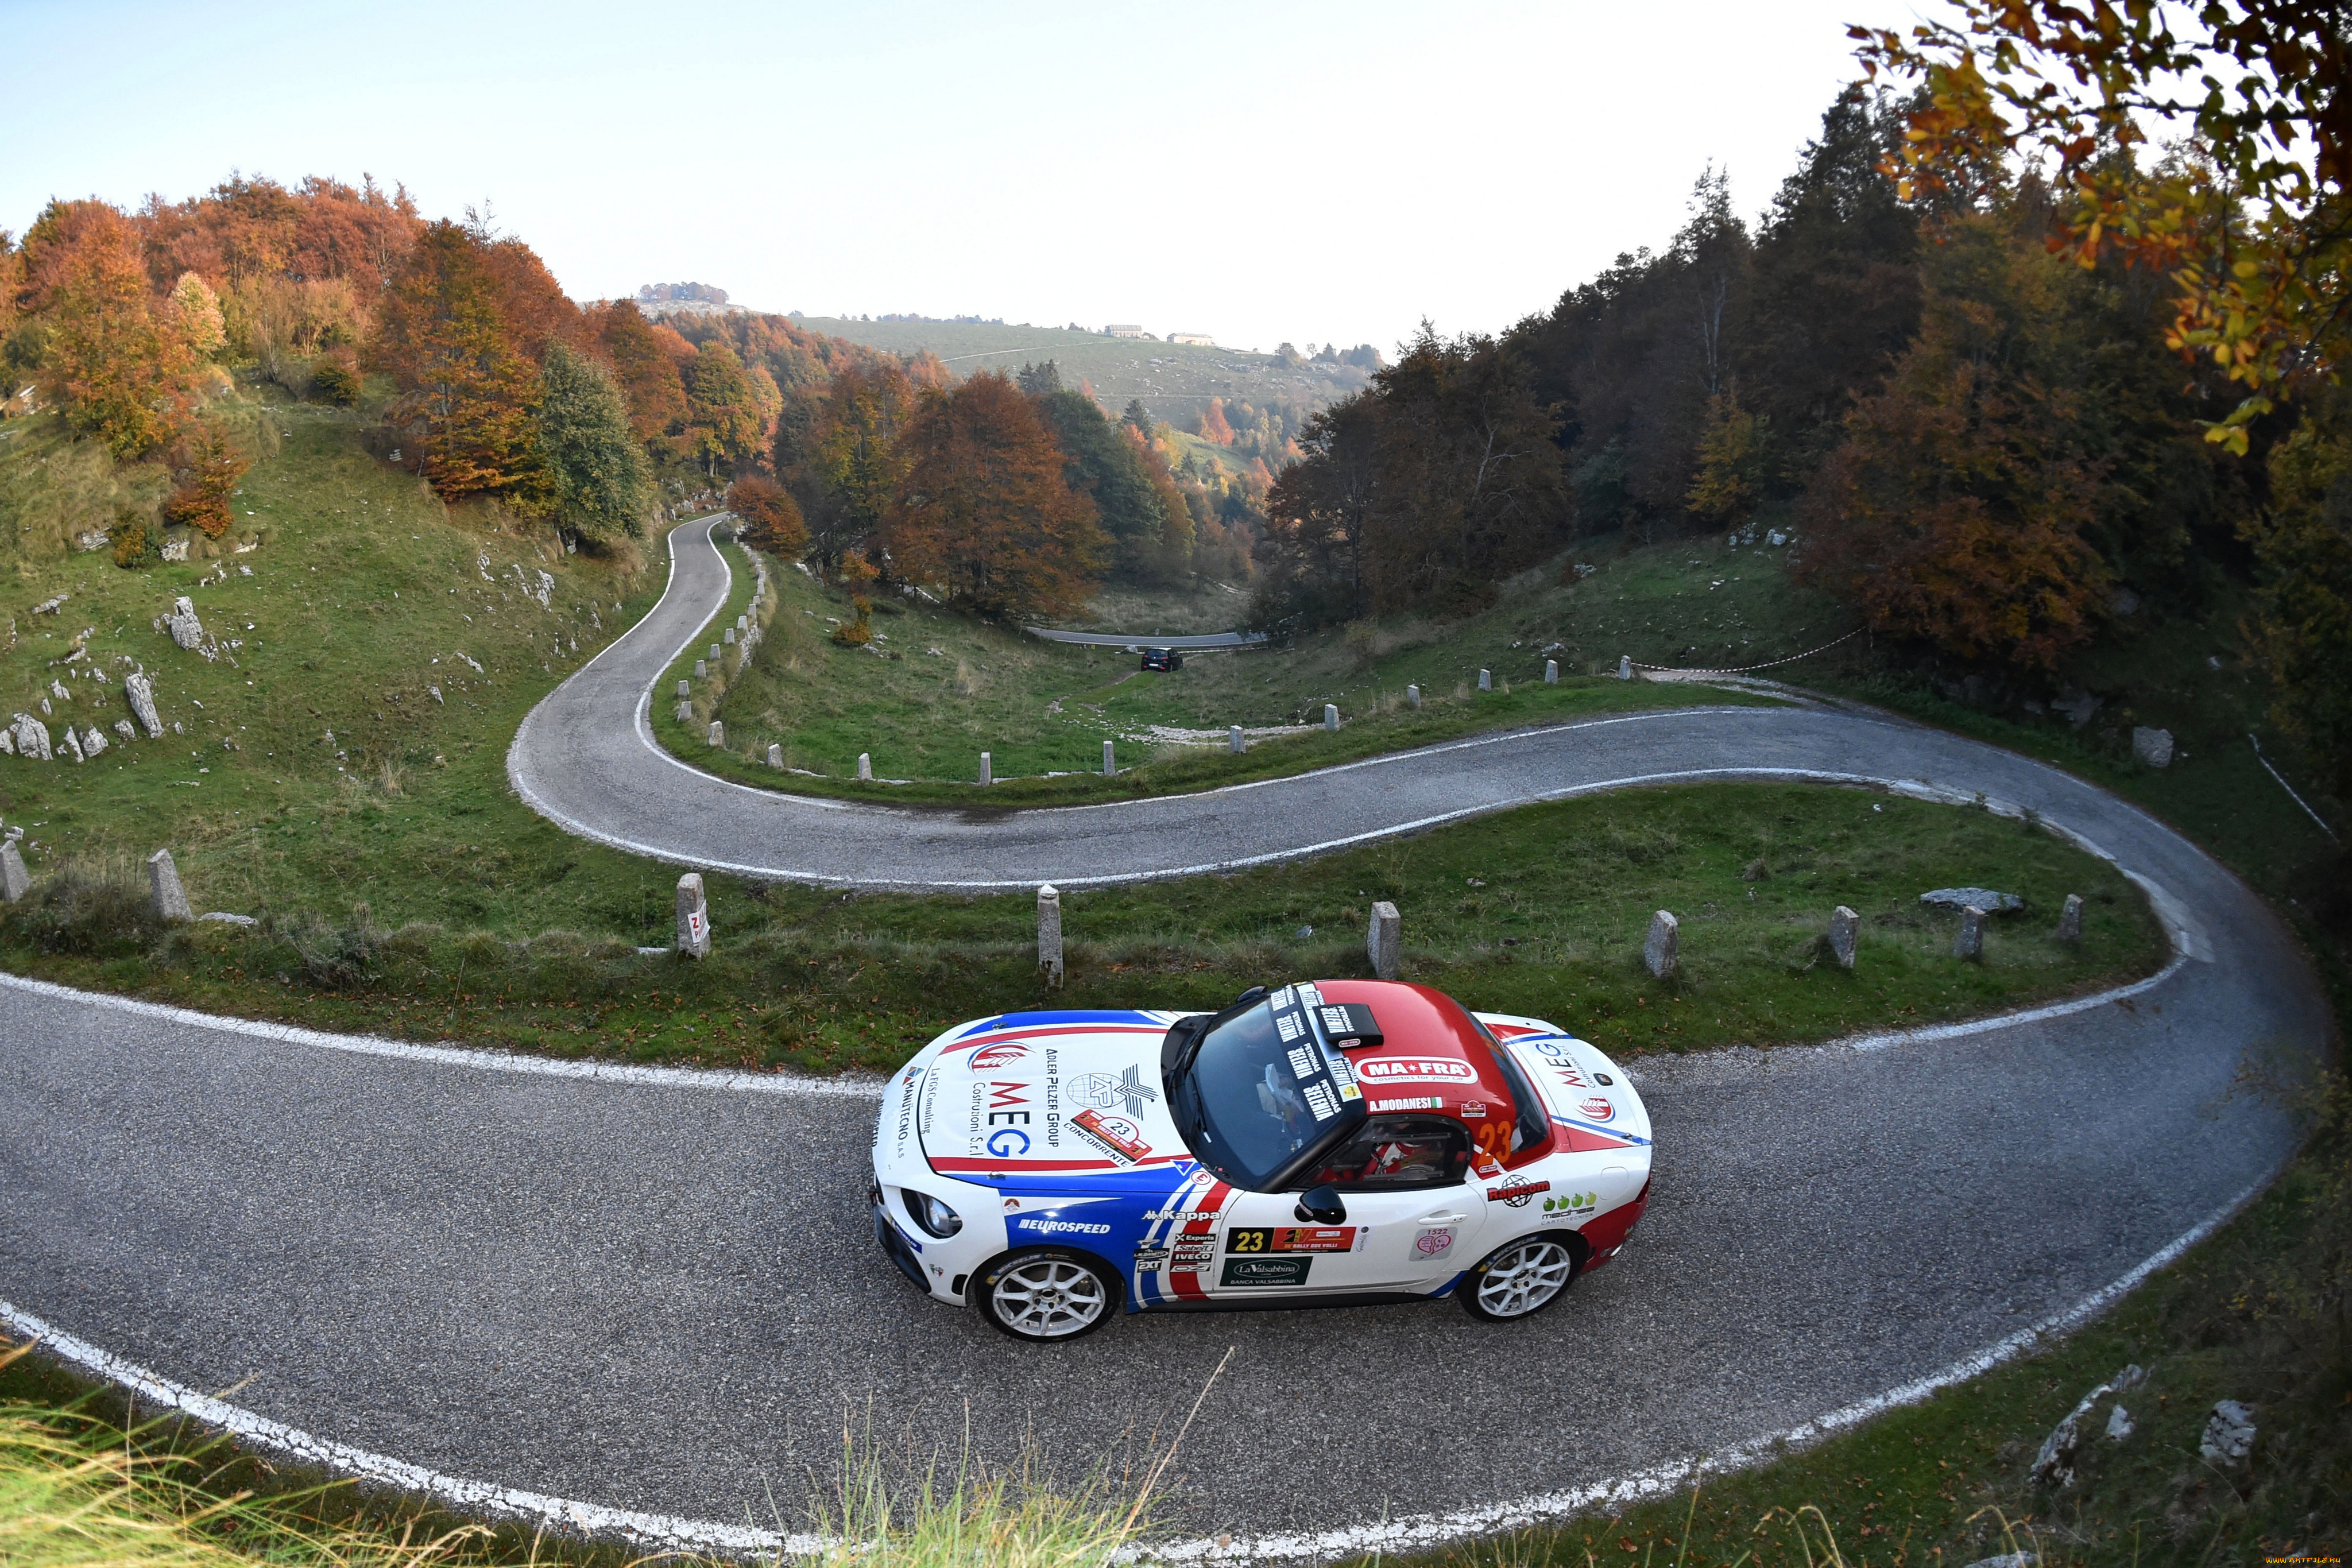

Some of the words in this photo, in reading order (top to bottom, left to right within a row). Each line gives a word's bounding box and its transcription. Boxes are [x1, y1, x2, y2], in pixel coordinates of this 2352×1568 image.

[1276, 1016, 1298, 1042] SELENIA
[1291, 1011, 1306, 1036] PETRONAS
[1320, 1008, 1347, 1033] SELENIA
[1337, 1006, 1355, 1032] PETRONAS
[1046, 1049, 1058, 1074] ADLER
[1287, 1047, 1314, 1079] SELENIA
[1304, 1043, 1321, 1072] PETRONAS
[1343, 1057, 1359, 1082] PETRONAS
[1535, 1044, 1587, 1087] MEG
[1328, 1059, 1352, 1086] SELENIA
[1046, 1077, 1058, 1110] PELZER
[1303, 1083, 1334, 1121] SELENIA
[1320, 1079, 1341, 1113] PETRONAS
[1370, 1097, 1432, 1112] A.MODANESI
[898, 1081, 915, 1140] MANUTECNO
[920, 1092, 937, 1135] Consulting
[970, 1082, 986, 1132] Costruzioni
[987, 1082, 1032, 1157] MEG
[1047, 1113, 1059, 1147] GROUP
[1110, 1122, 1130, 1135] 23
[1063, 1122, 1130, 1167] CONCORRENTE
[1477, 1121, 1511, 1166] 23
[1488, 1181, 1549, 1201] Rapicom
[1163, 1210, 1220, 1221] Kappa
[1541, 1213, 1593, 1225] CARTOTECNICA
[1542, 1207, 1595, 1219] medhea
[1028, 1220, 1111, 1234] EUROSPEED
[1235, 1232, 1263, 1251] 23
[1250, 1264, 1295, 1273] Valsabbina
